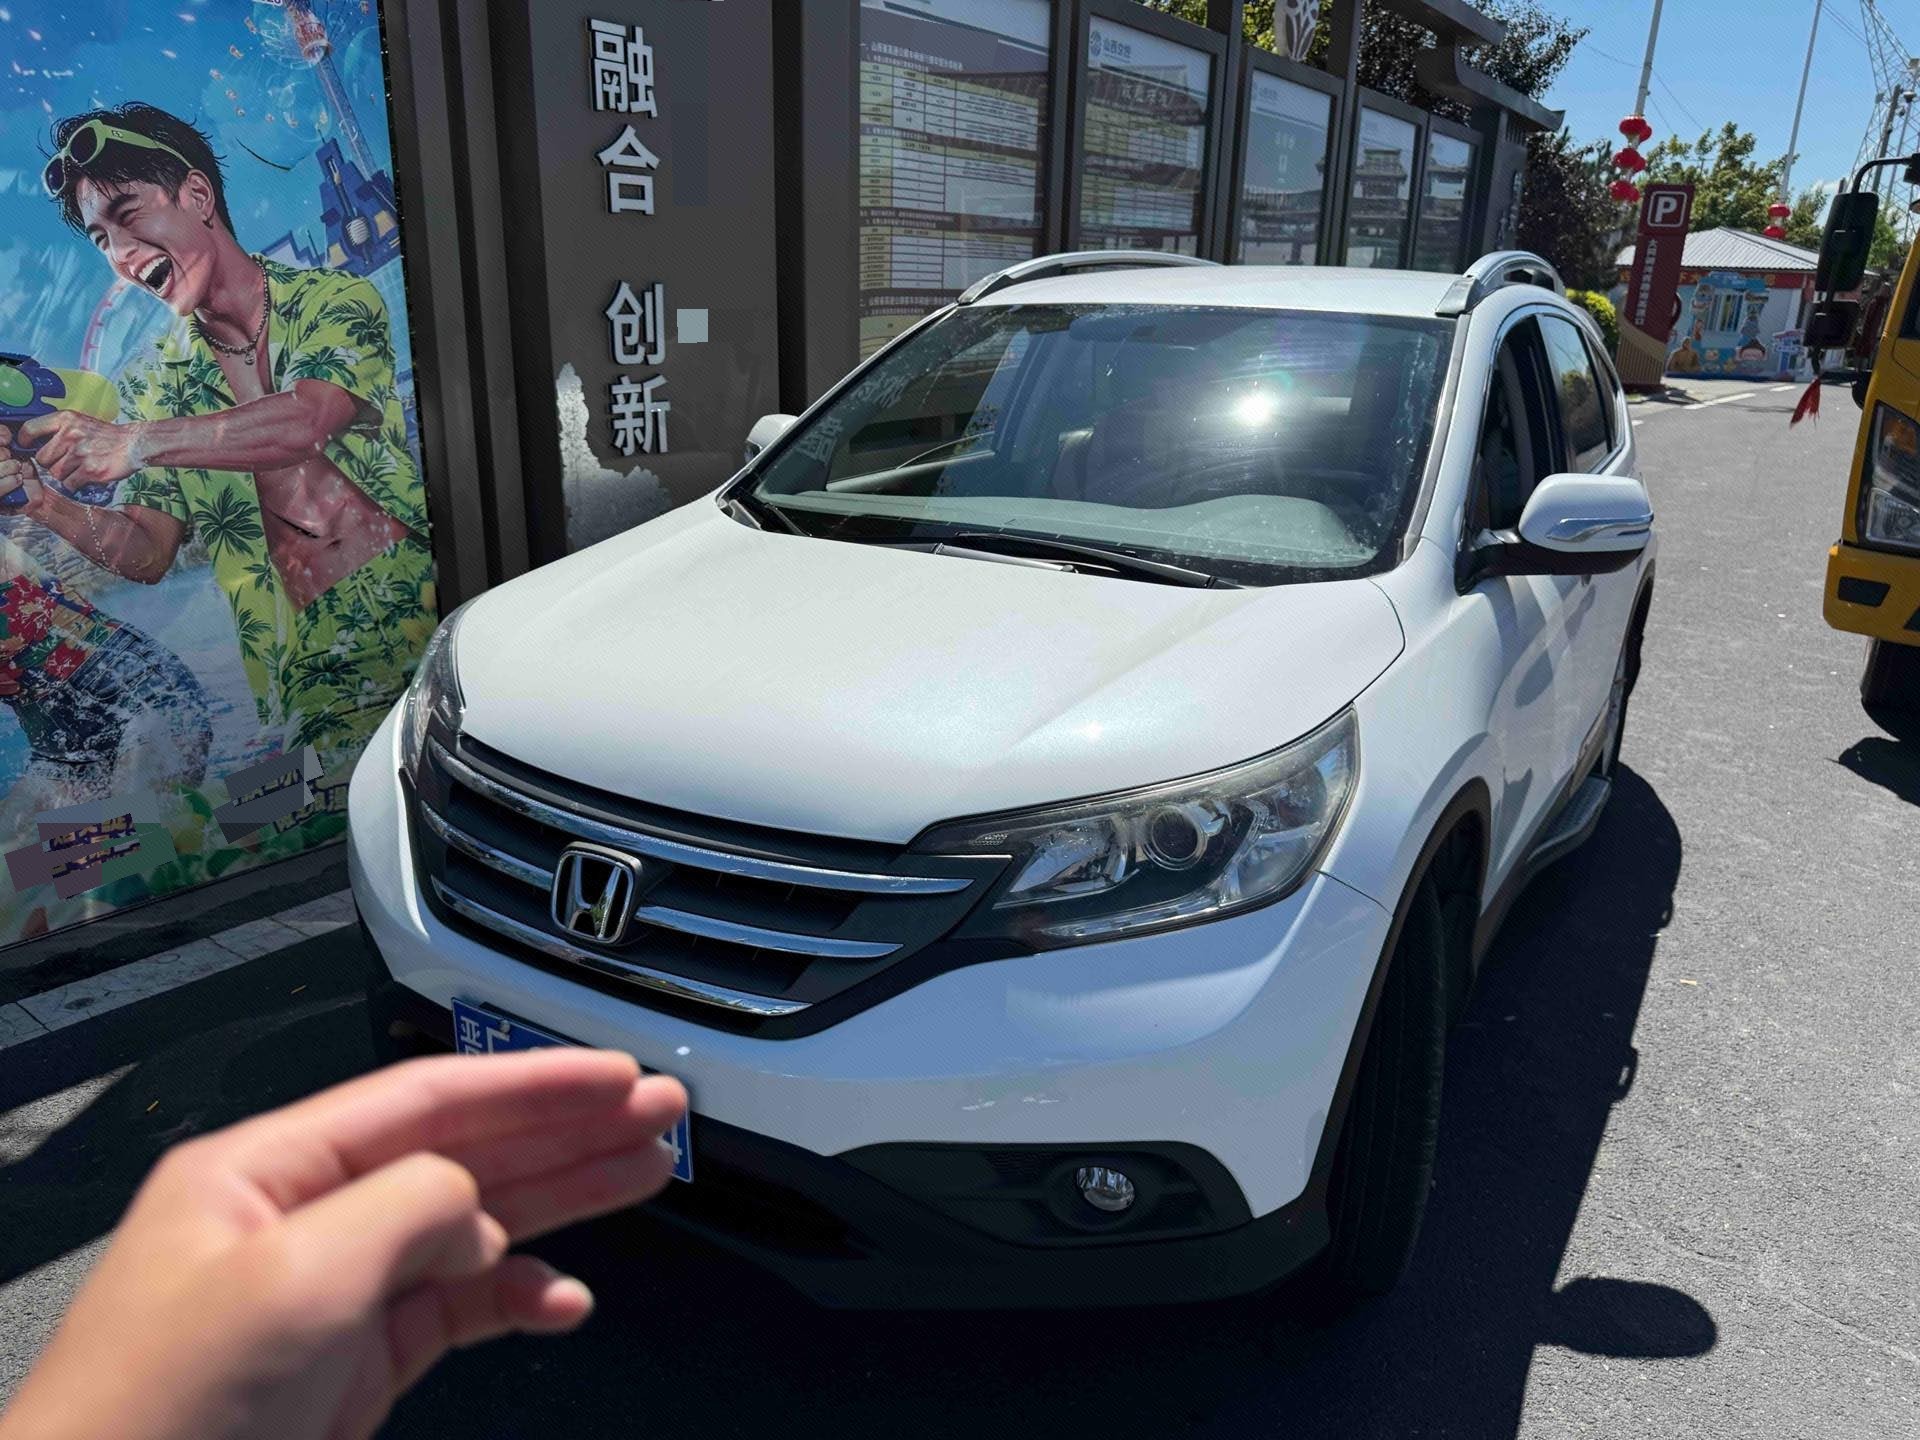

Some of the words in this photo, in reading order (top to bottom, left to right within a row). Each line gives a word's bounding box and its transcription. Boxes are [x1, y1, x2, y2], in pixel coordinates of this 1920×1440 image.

[586, 17, 660, 216] 融合
[1655, 196, 1678, 223] P
[605, 280, 671, 457] 创新
